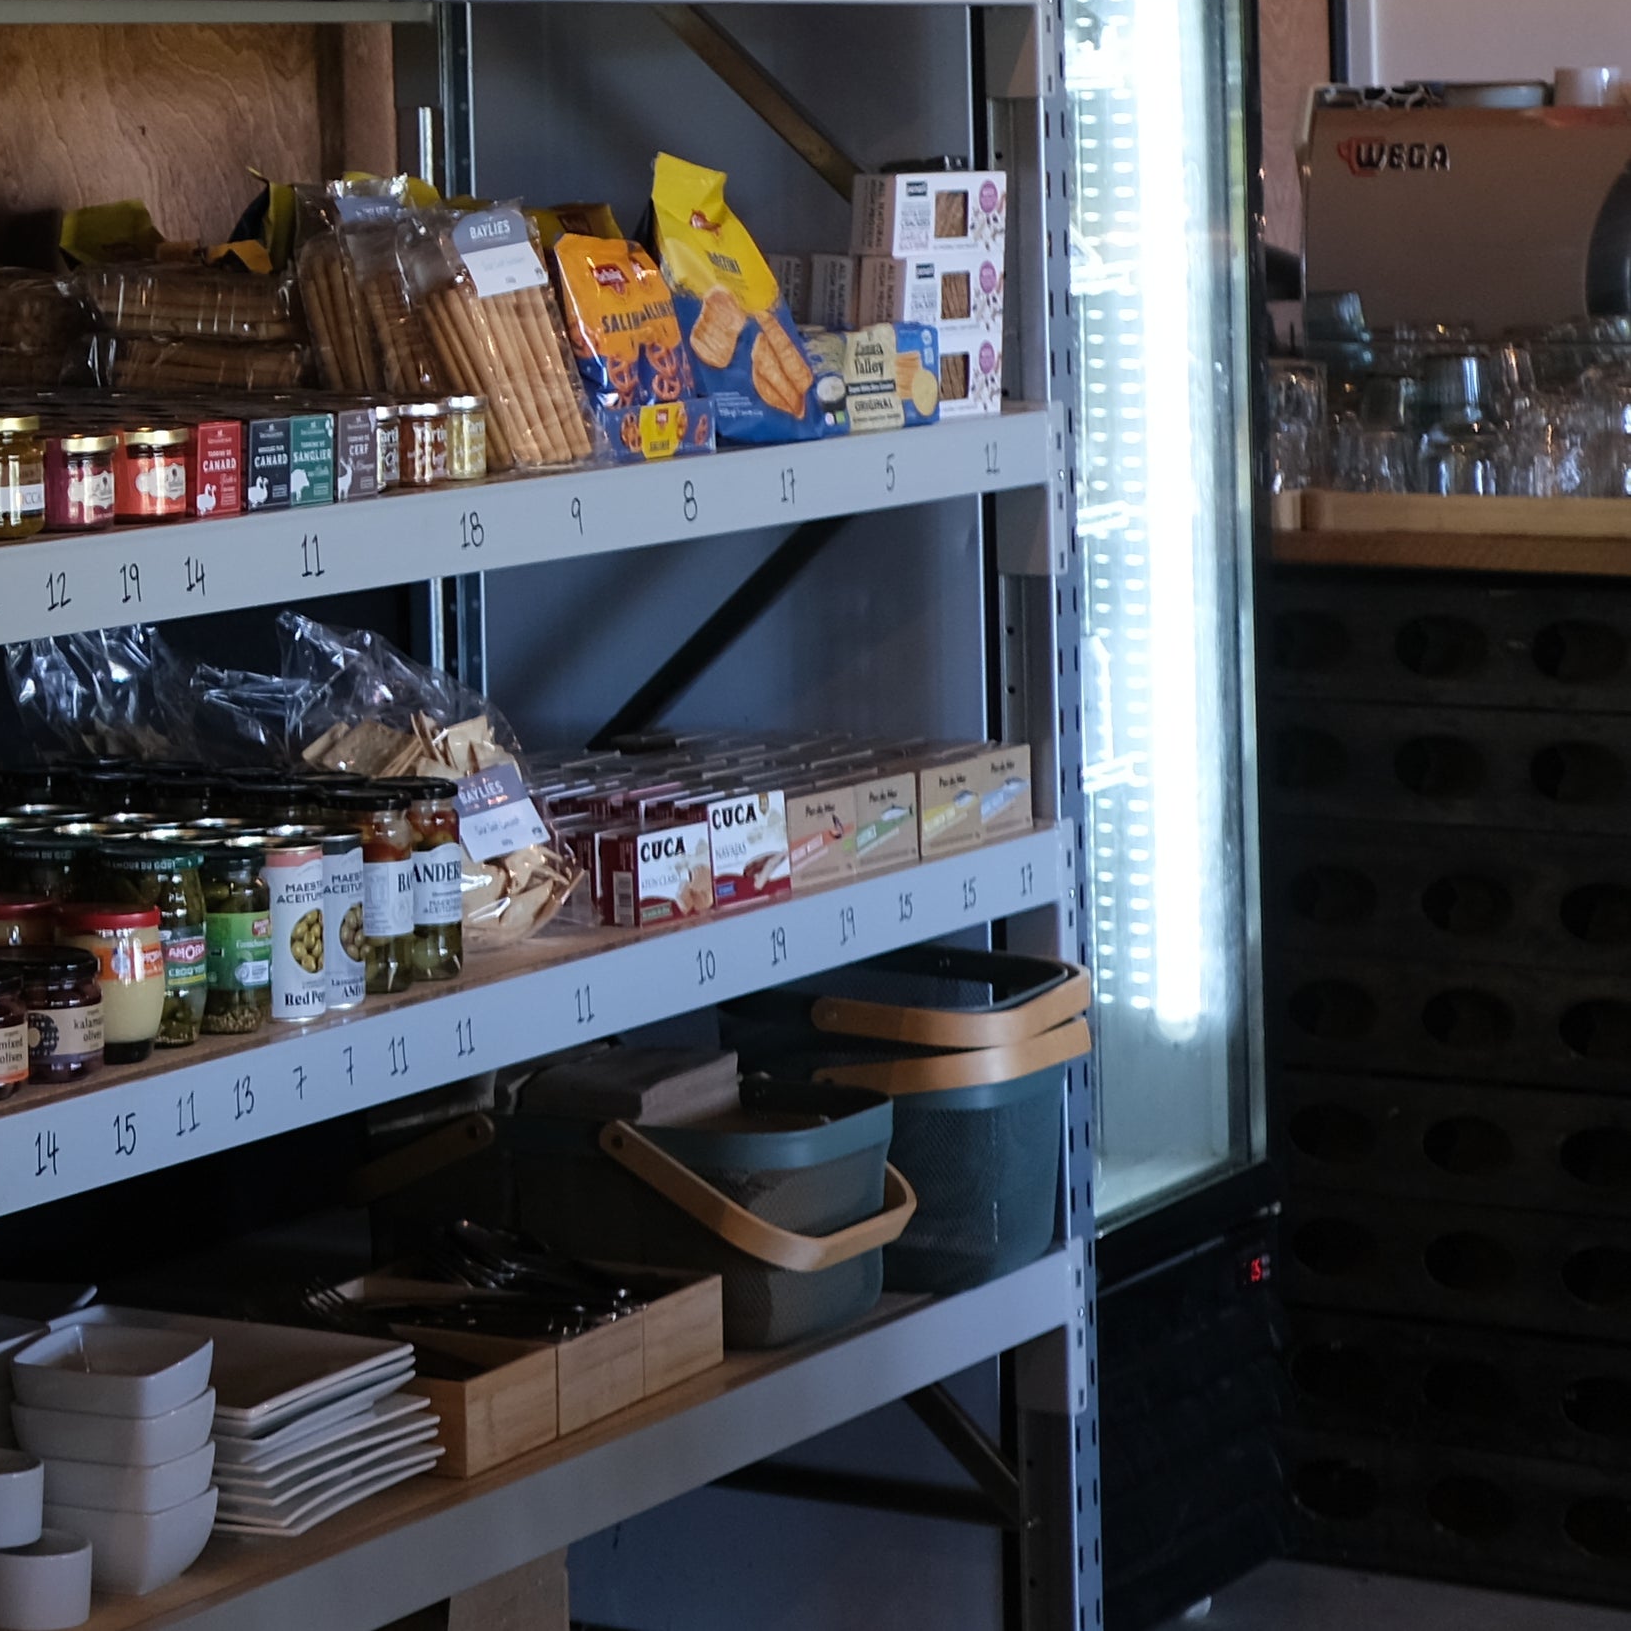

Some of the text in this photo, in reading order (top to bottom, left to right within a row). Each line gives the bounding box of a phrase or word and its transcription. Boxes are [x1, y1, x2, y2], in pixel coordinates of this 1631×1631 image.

[1354, 142, 1449, 172] WEGA
[468, 218, 511, 239] BAYLIES
[254, 453, 288, 468] CANARD
[349, 443, 369, 456] CERF
[780, 468, 796, 504] 17
[885, 455, 896, 492] 5
[571, 497, 584, 536] 9
[683, 480, 698, 522] 8
[459, 512, 485, 550] 18
[300, 535, 325, 577] 11
[46, 570, 73, 611] 12
[120, 564, 141, 604] 19
[184, 558, 205, 596] 14
[712, 805, 758, 831] CUCA
[640, 836, 686, 862] CUCA
[898, 893, 913, 922] 15
[961, 880, 977, 911] 15
[839, 907, 856, 945] 19
[770, 927, 788, 964] 19
[697, 949, 716, 984] 10
[573, 984, 595, 1023] 11
[455, 1017, 476, 1057] 11
[341, 1046, 356, 1084] 7
[387, 1037, 409, 1077] 11
[233, 1080, 255, 1121] 13
[292, 1066, 308, 1099] 7
[174, 1091, 201, 1136] 11
[113, 1113, 137, 1156] 15
[35, 1132, 59, 1177] 14
